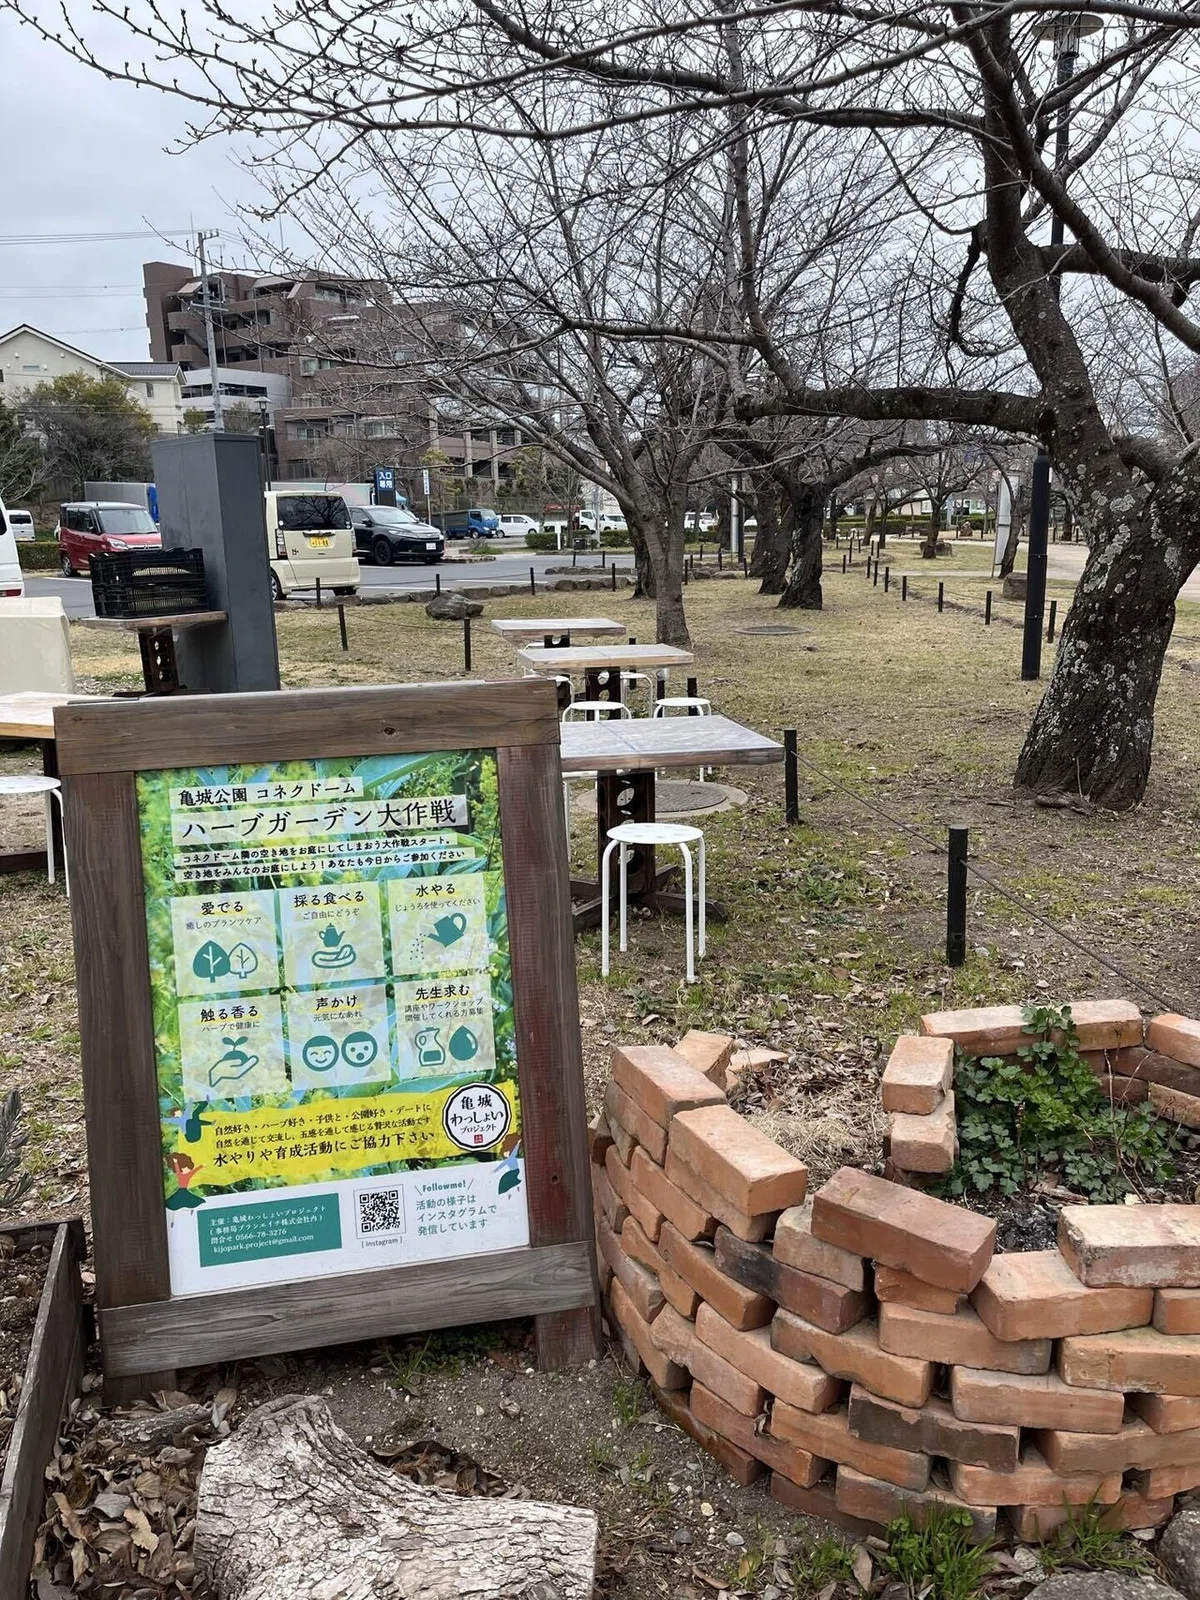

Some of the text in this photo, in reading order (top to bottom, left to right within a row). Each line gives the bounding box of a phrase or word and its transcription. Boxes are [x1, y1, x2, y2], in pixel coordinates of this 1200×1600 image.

[379, 471, 392, 480] 入口
[178, 782, 356, 807] 亀城公園 コネクドーム
[182, 799, 457, 839] ハーブガーデン大作戦
[183, 836, 450, 864] コネクドーム隣の空き地をお庭にしてしまおう大作戦スタート。
[183, 850, 466, 880] 空き地をみんなのお庭にしよう！あなたも今日からご参加ください
[415, 883, 456, 898] 水やる
[293, 891, 365, 908] 採る食べる
[395, 898, 481, 913] じょうろを使ってください
[201, 901, 244, 916] 愛でる
[303, 908, 360, 920] ご自由にどうぞ
[415, 984, 471, 1001] 先生求む
[315, 994, 358, 1011] 声かけ
[404, 997, 484, 1013] 講座やワークショップ
[200, 1005, 259, 1023] 触る香る
[313, 1010, 362, 1022] 元気になあれ
[404, 1007, 484, 1023] 開催してくれる方募集
[201, 1021, 260, 1033] ハーブで健康に
[461, 1093, 493, 1110] 亀城
[450, 1110, 504, 1127] わっしょい
[460, 1123, 497, 1134] プロジェクト
[213, 1131, 435, 1168] 水やりや育成活動にご協力下さい
[416, 1194, 477, 1212] 活動の様子は
[417, 1204, 498, 1224] インスタグラムで
[235, 1228, 287, 1242] 0566-78-3276
[417, 1218, 488, 1237] 発信しています
[213, 1234, 315, 1255] kijopark.project@gmail.com
